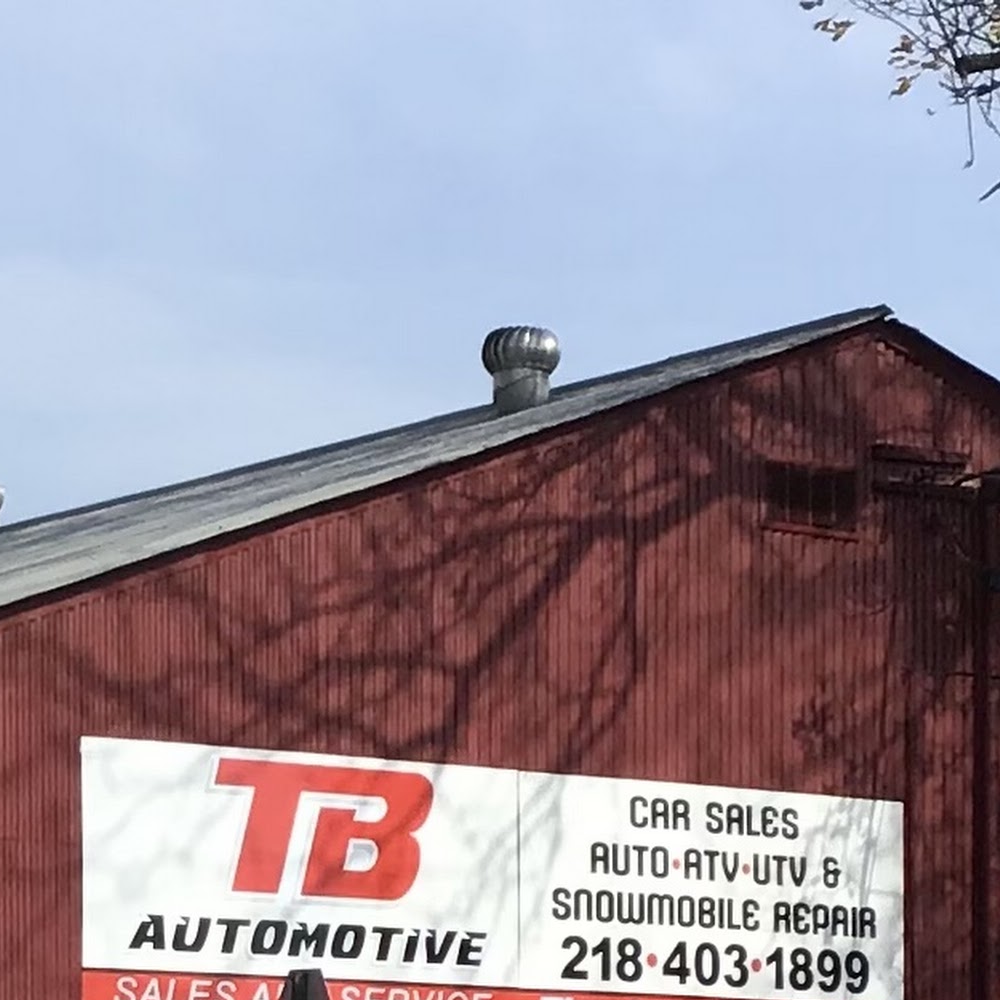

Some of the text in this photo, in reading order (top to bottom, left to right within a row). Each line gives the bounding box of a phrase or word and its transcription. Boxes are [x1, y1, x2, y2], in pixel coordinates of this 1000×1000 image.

[214, 757, 434, 902] TB
[629, 796, 800, 840] CAR SALES
[822, 856, 842, 888] &
[552, 887, 876, 939] SNOWMOBILE REPAIR
[128, 914, 488, 967] AUTOMOTIVE
